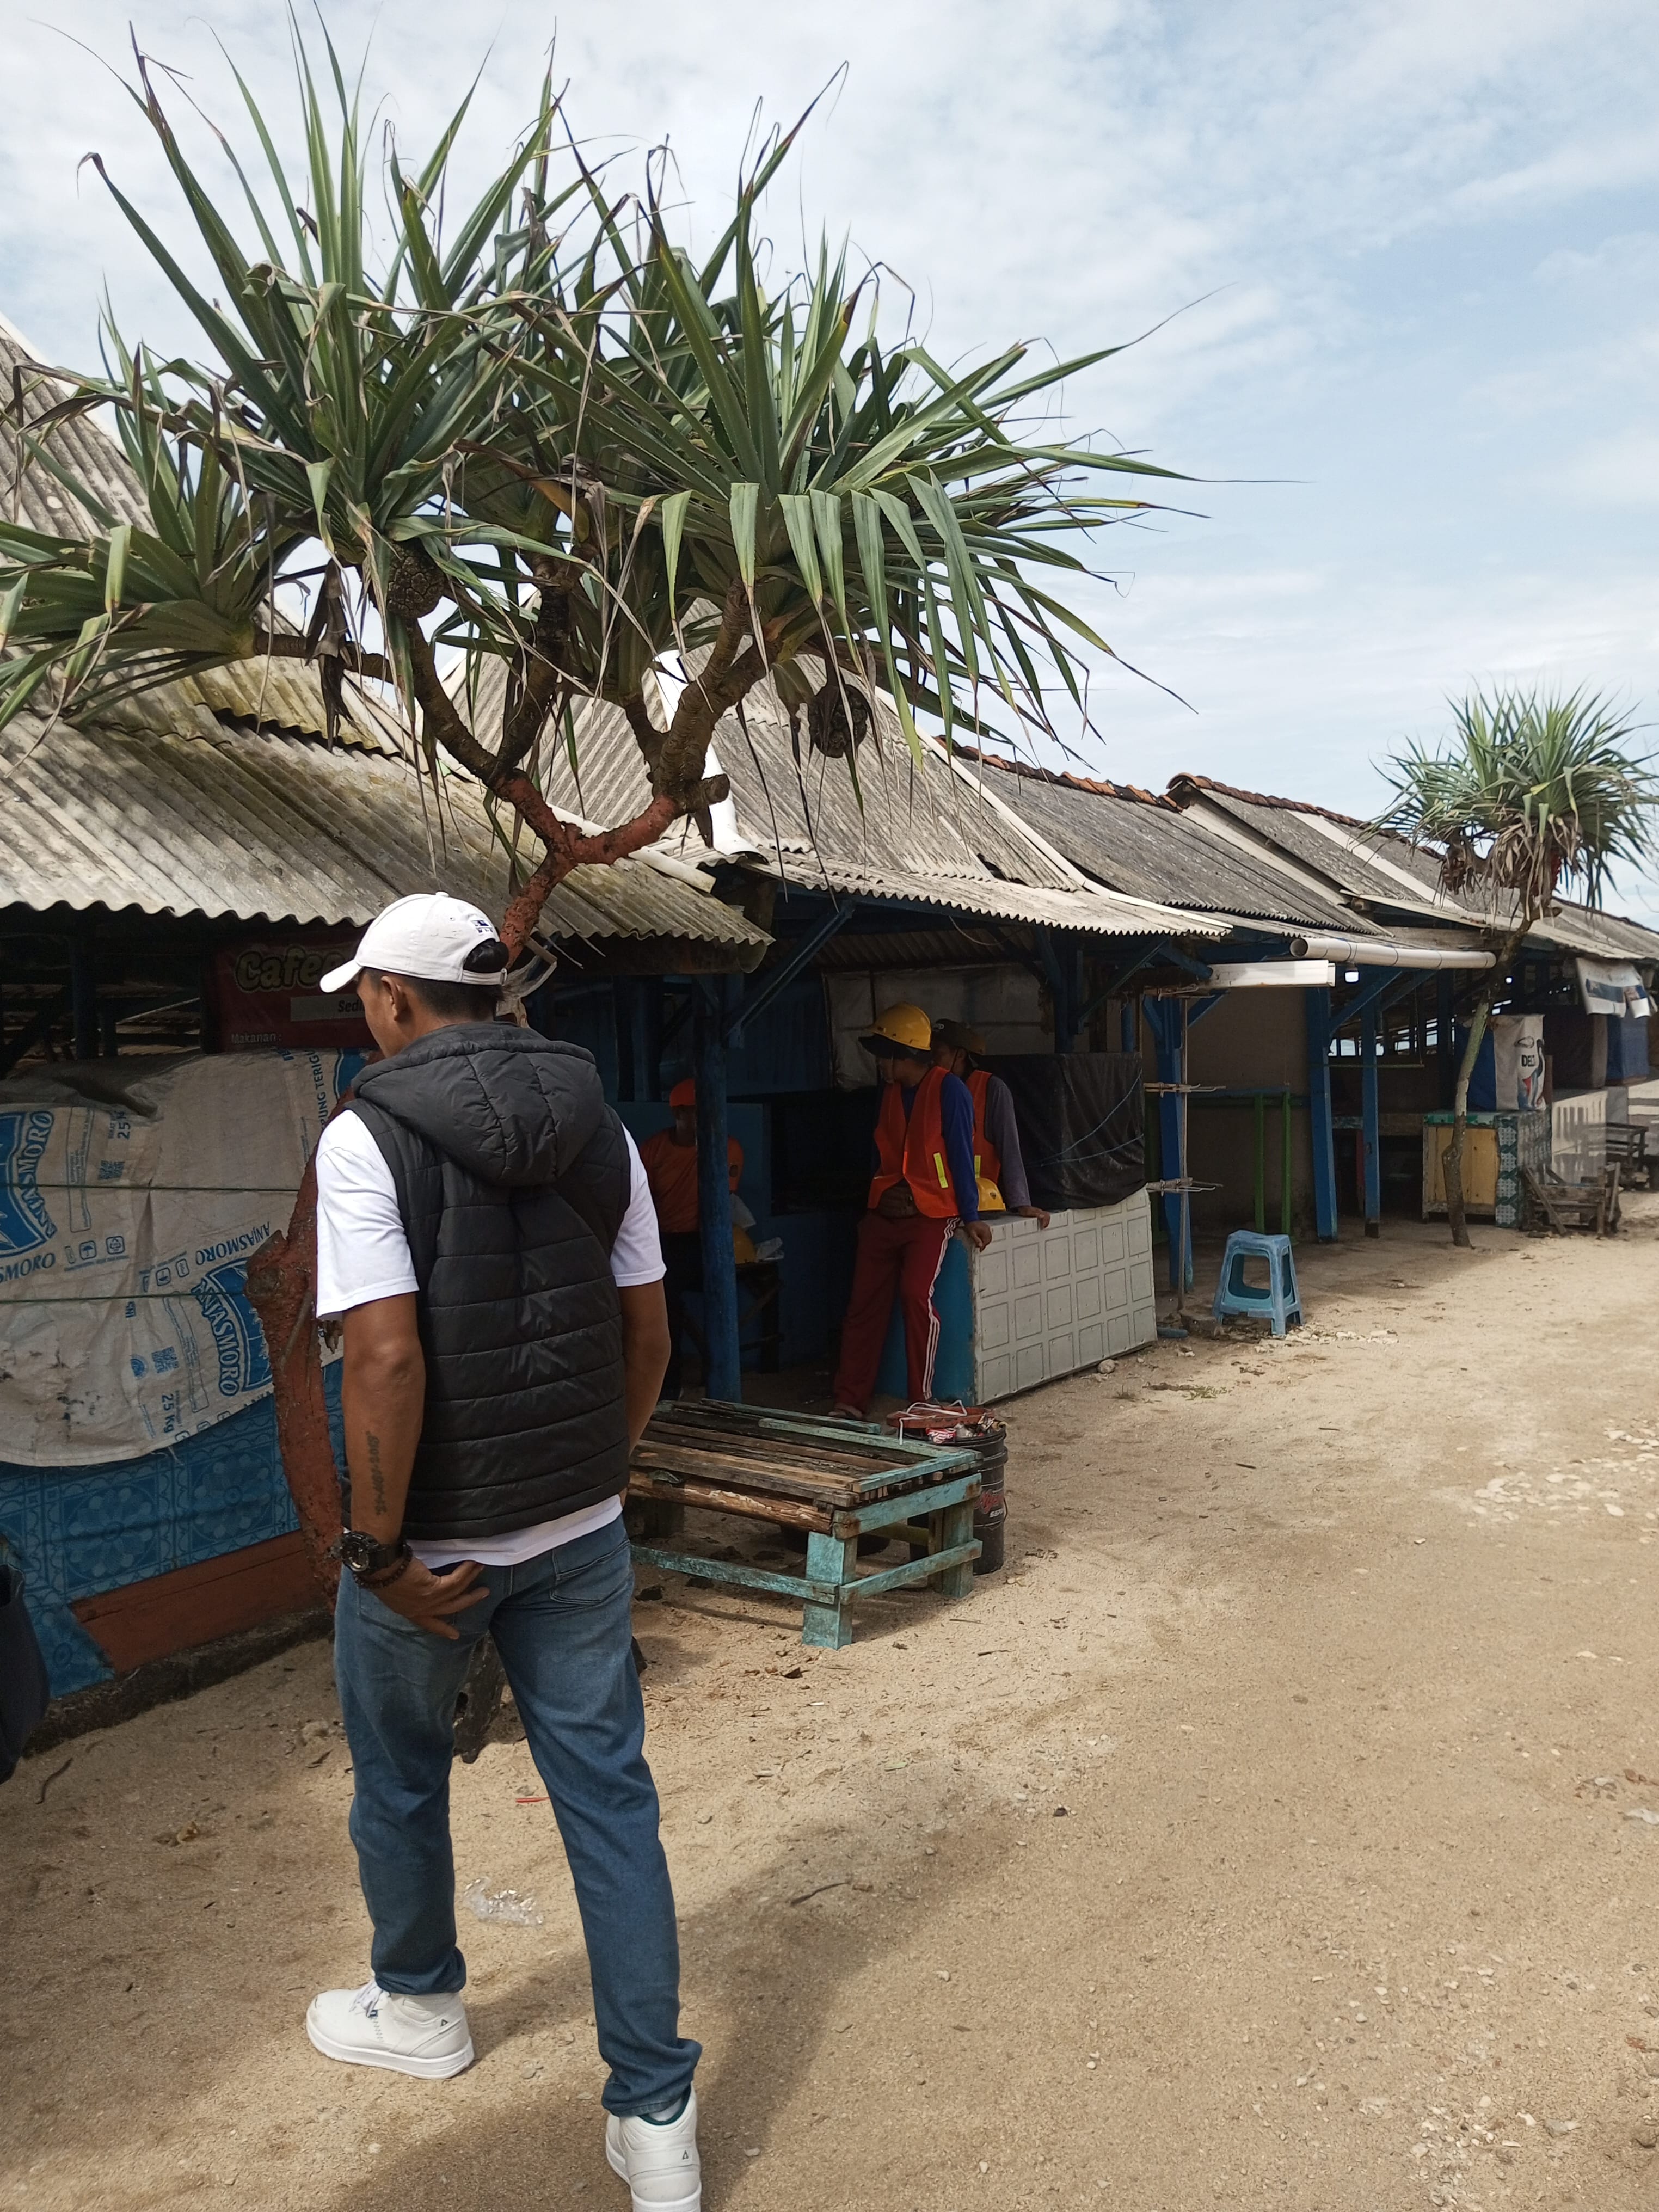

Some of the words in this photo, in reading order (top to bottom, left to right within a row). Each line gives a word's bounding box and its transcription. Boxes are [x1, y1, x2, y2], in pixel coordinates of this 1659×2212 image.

[116, 1121, 131, 1140] 25
[17, 1110, 58, 1239] ANJASMORO
[195, 1221, 271, 1265] ANJASMORO
[191, 1278, 239, 1397] ANJASMORO
[162, 1393, 175, 1412] 25
[163, 1415, 176, 1434] Kg
